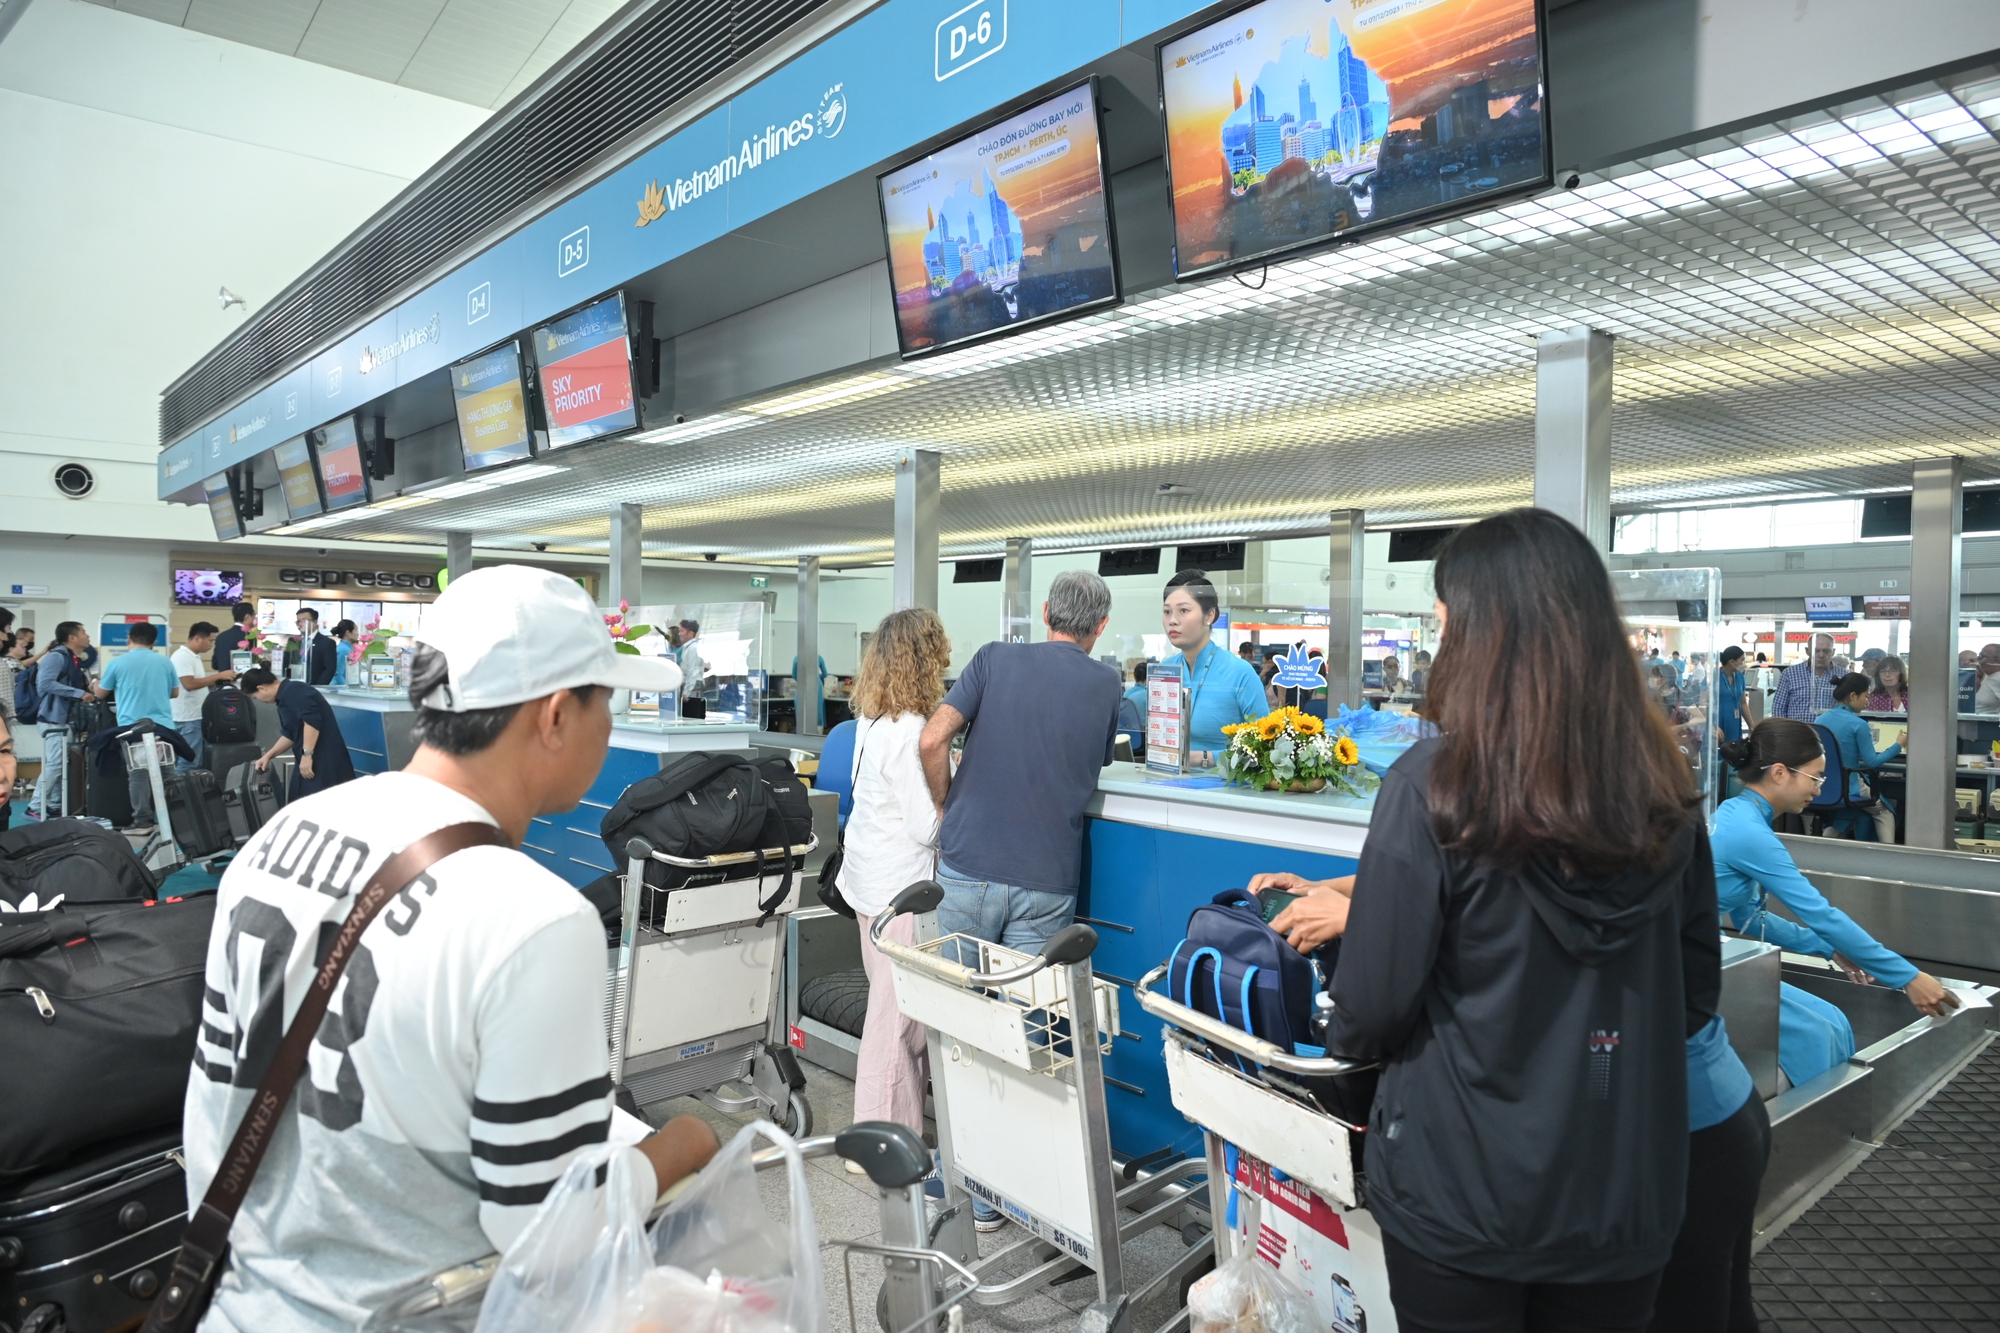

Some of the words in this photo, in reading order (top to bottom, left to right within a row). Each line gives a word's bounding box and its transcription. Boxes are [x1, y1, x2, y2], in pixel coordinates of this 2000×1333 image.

[949, 11, 991, 61] D-6
[978, 141, 999, 156] CHÀO
[1000, 132, 1017, 147] ĐÓN
[1049, 110, 1065, 125] BAY
[994, 145, 1021, 163] TP.HCM
[1056, 124, 1068, 137] ÚC
[666, 155, 737, 210] Vietnam
[737, 112, 815, 175] Airlines
[565, 239, 583, 266] D-5
[472, 292, 485, 315] D-4
[552, 374, 572, 396] SKY
[555, 383, 602, 414] PRIORITY
[279, 568, 434, 588] espresso
[248, 815, 438, 937] ADIDS
[319, 883, 385, 991] SENXIANG
[680, 1044, 705, 1056] BIZMAN
[222, 1091, 278, 1193] SENXIANG
[1004, 1200, 1029, 1222] BIZMAN
[1053, 1229, 1065, 1244] SG
[1067, 1238, 1088, 1260] 1094
